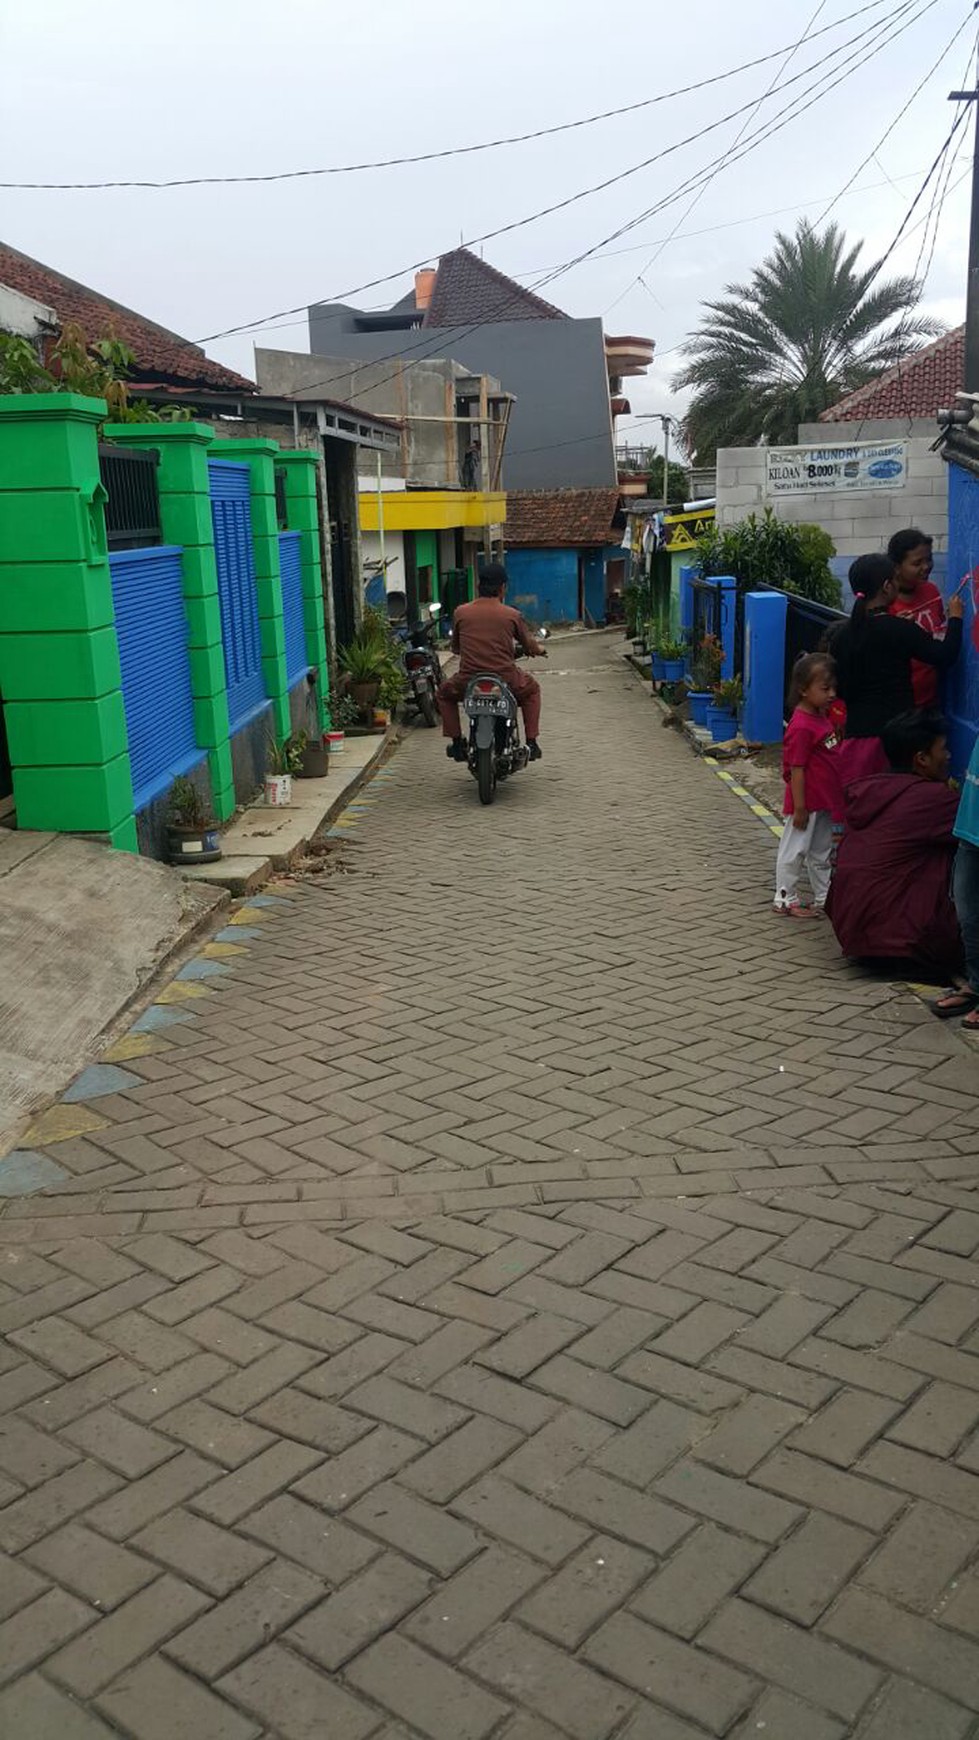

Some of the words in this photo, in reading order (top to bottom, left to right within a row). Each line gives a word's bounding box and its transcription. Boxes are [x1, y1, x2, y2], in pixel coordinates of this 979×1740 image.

[810, 447, 860, 462] LAUNDRY
[769, 466, 801, 480] KILOAN
[808, 464, 834, 479] 8.000
